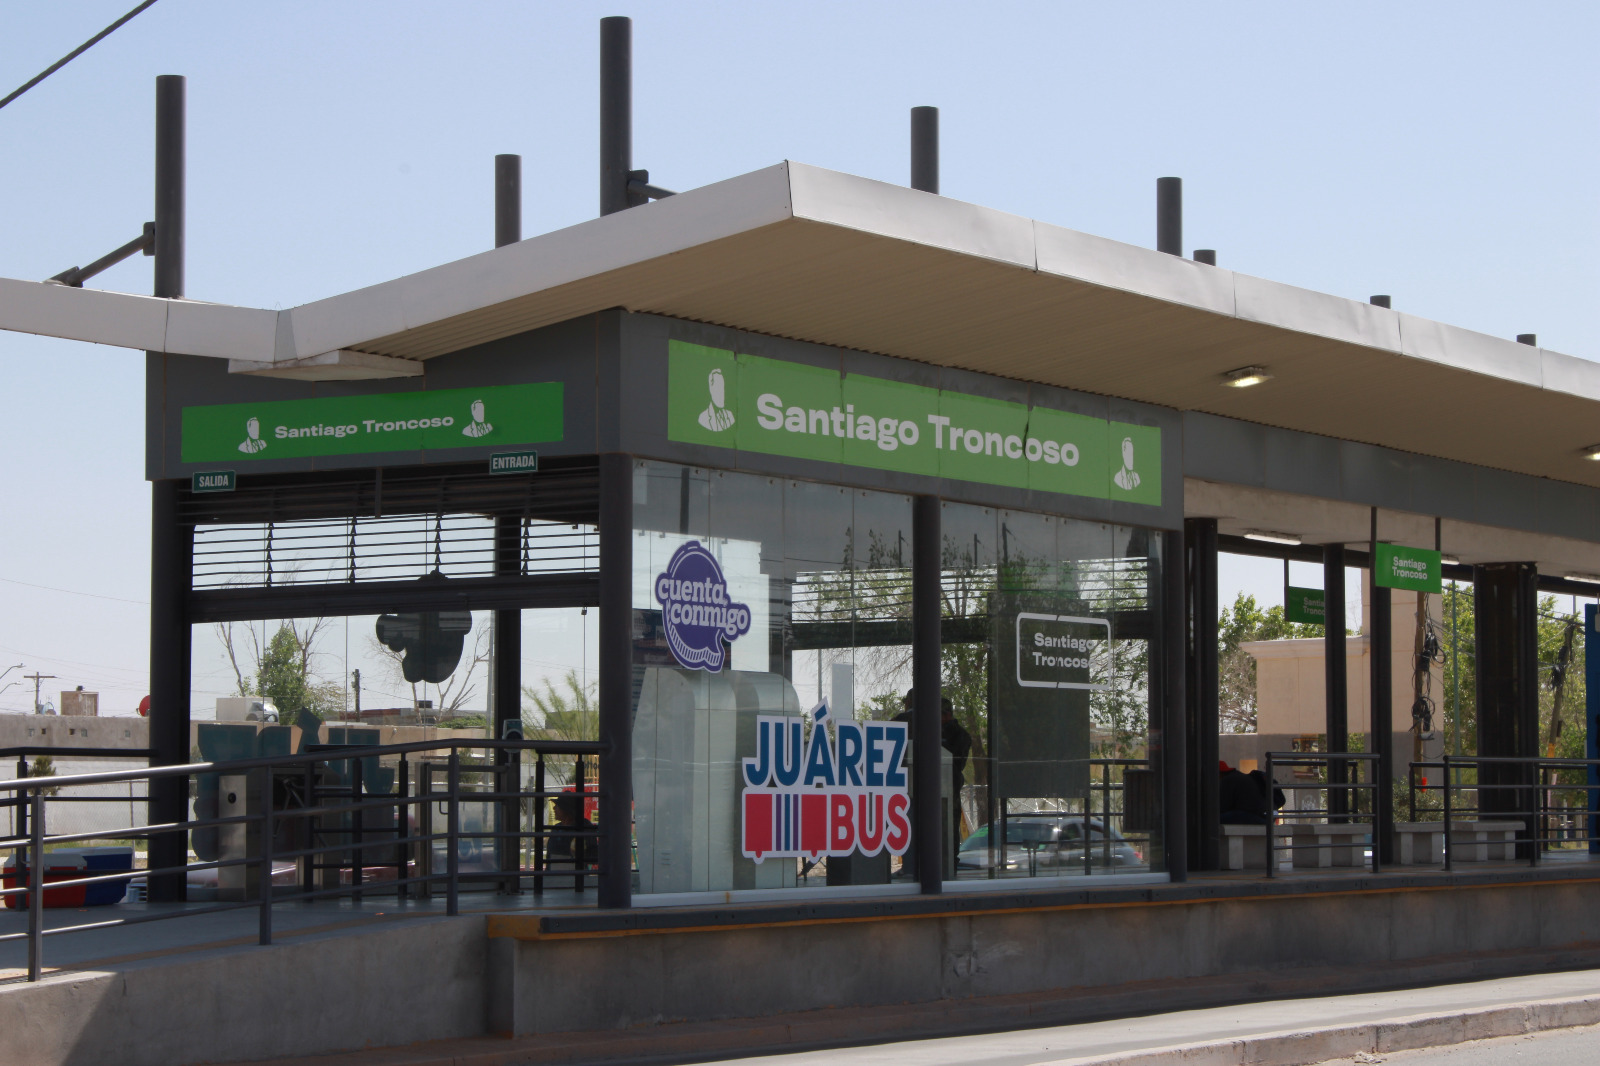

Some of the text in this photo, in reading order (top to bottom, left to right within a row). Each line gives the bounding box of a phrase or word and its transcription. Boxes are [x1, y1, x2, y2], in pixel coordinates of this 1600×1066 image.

[275, 416, 454, 439] Santiago Troncoso
[757, 393, 1079, 467] Santiago Troncoso
[492, 455, 535, 470] ENTRADA
[199, 475, 229, 488] SALIDA
[1392, 567, 1427, 580] Troncoso
[1393, 556, 1427, 571] Santiago
[658, 577, 725, 605] cuenta
[670, 603, 749, 636] conmigo
[1034, 632, 1095, 652] Santiago
[1032, 651, 1096, 668] Troncoso
[745, 704, 906, 786] JUÁREZ
[830, 793, 909, 851] BUS
